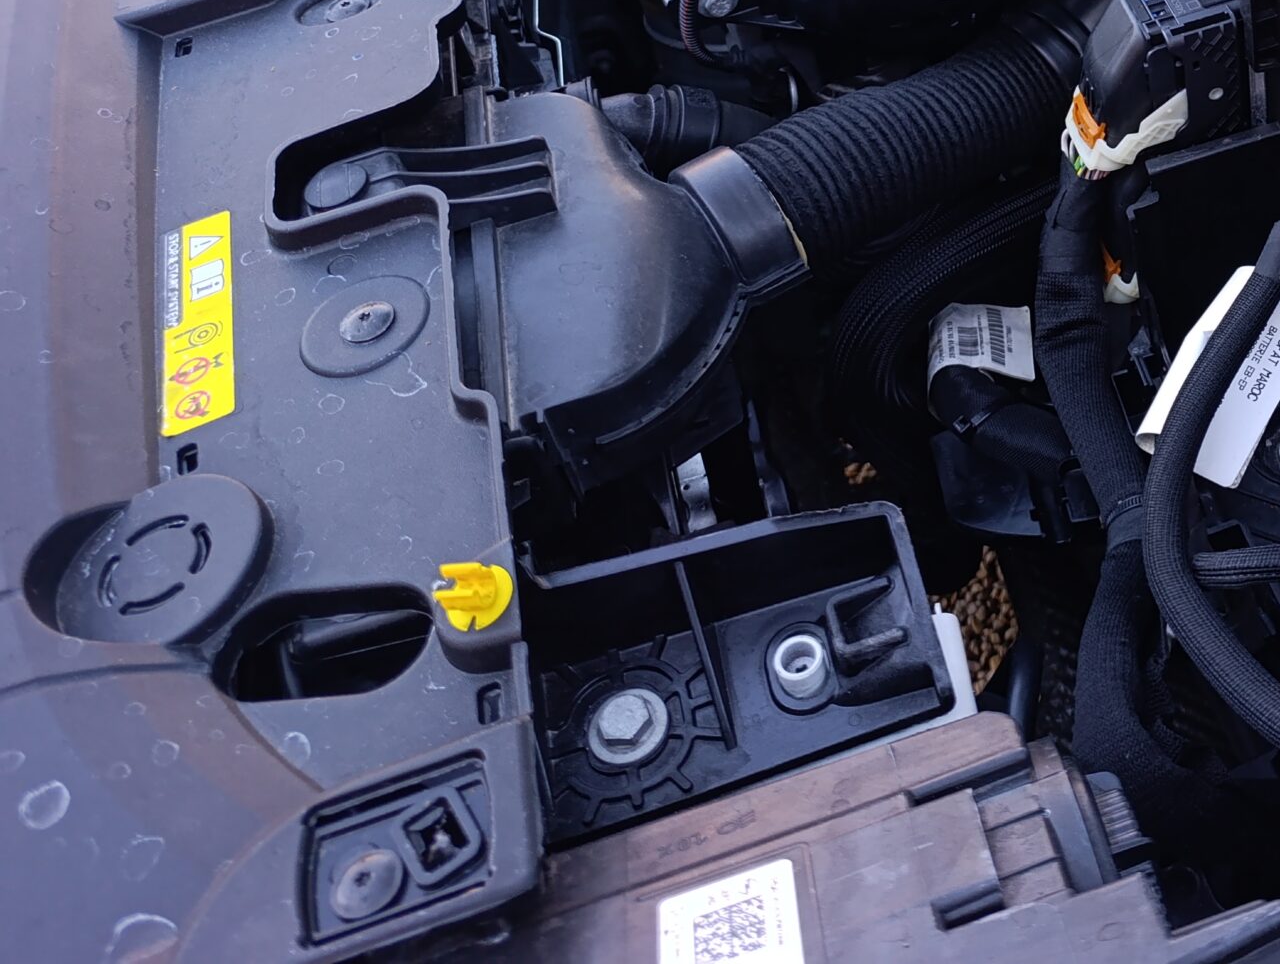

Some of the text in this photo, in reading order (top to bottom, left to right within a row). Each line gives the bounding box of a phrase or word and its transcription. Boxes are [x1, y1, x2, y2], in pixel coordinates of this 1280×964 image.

[168, 233, 179, 254] STOP
[168, 264, 179, 289] START
[167, 290, 179, 327] SYSTEM
[1251, 325, 1278, 364] BATTERIE
[1237, 365, 1256, 391] EB-EP
[1247, 368, 1273, 402] MAROC
